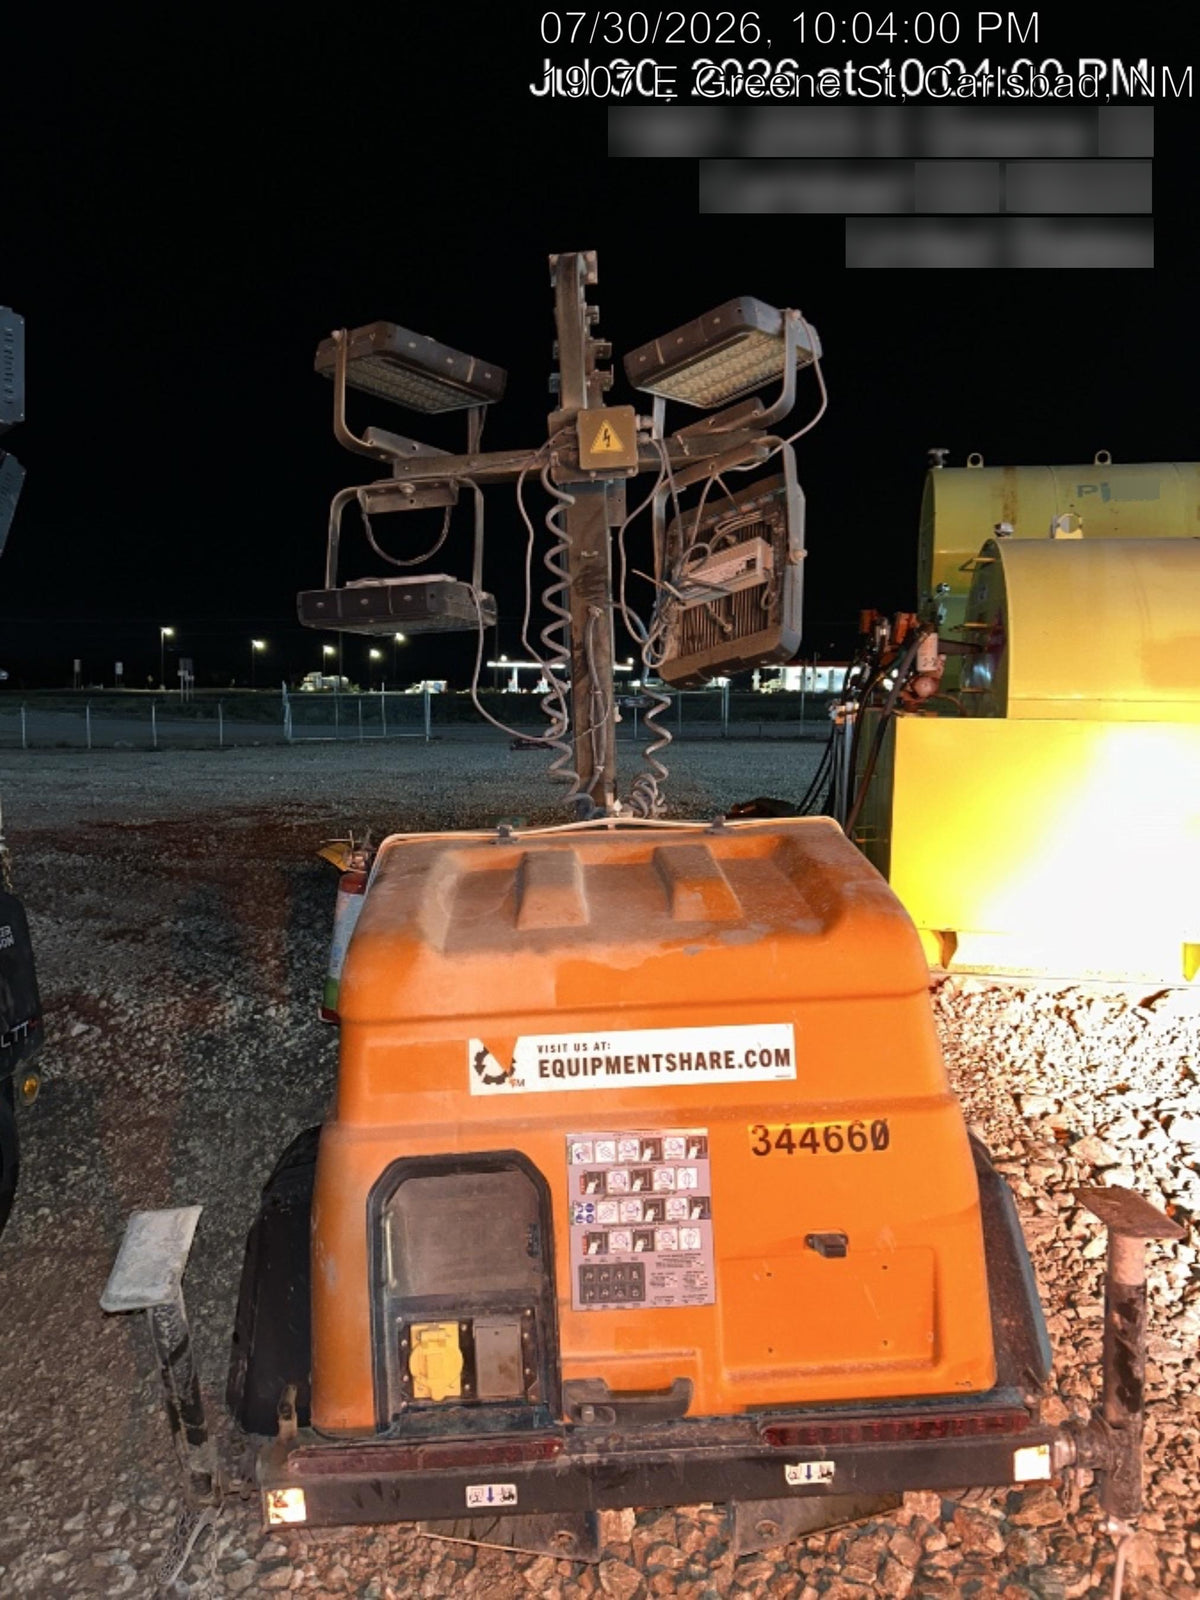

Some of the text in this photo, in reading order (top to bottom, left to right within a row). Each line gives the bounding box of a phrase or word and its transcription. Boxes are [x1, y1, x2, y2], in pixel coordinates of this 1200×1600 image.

[537, 1041, 611, 1054] VISIT US AT:
[538, 1047, 790, 1079] EQUIPMENTSHARE.COM
[751, 1118, 890, 1157] 344660
